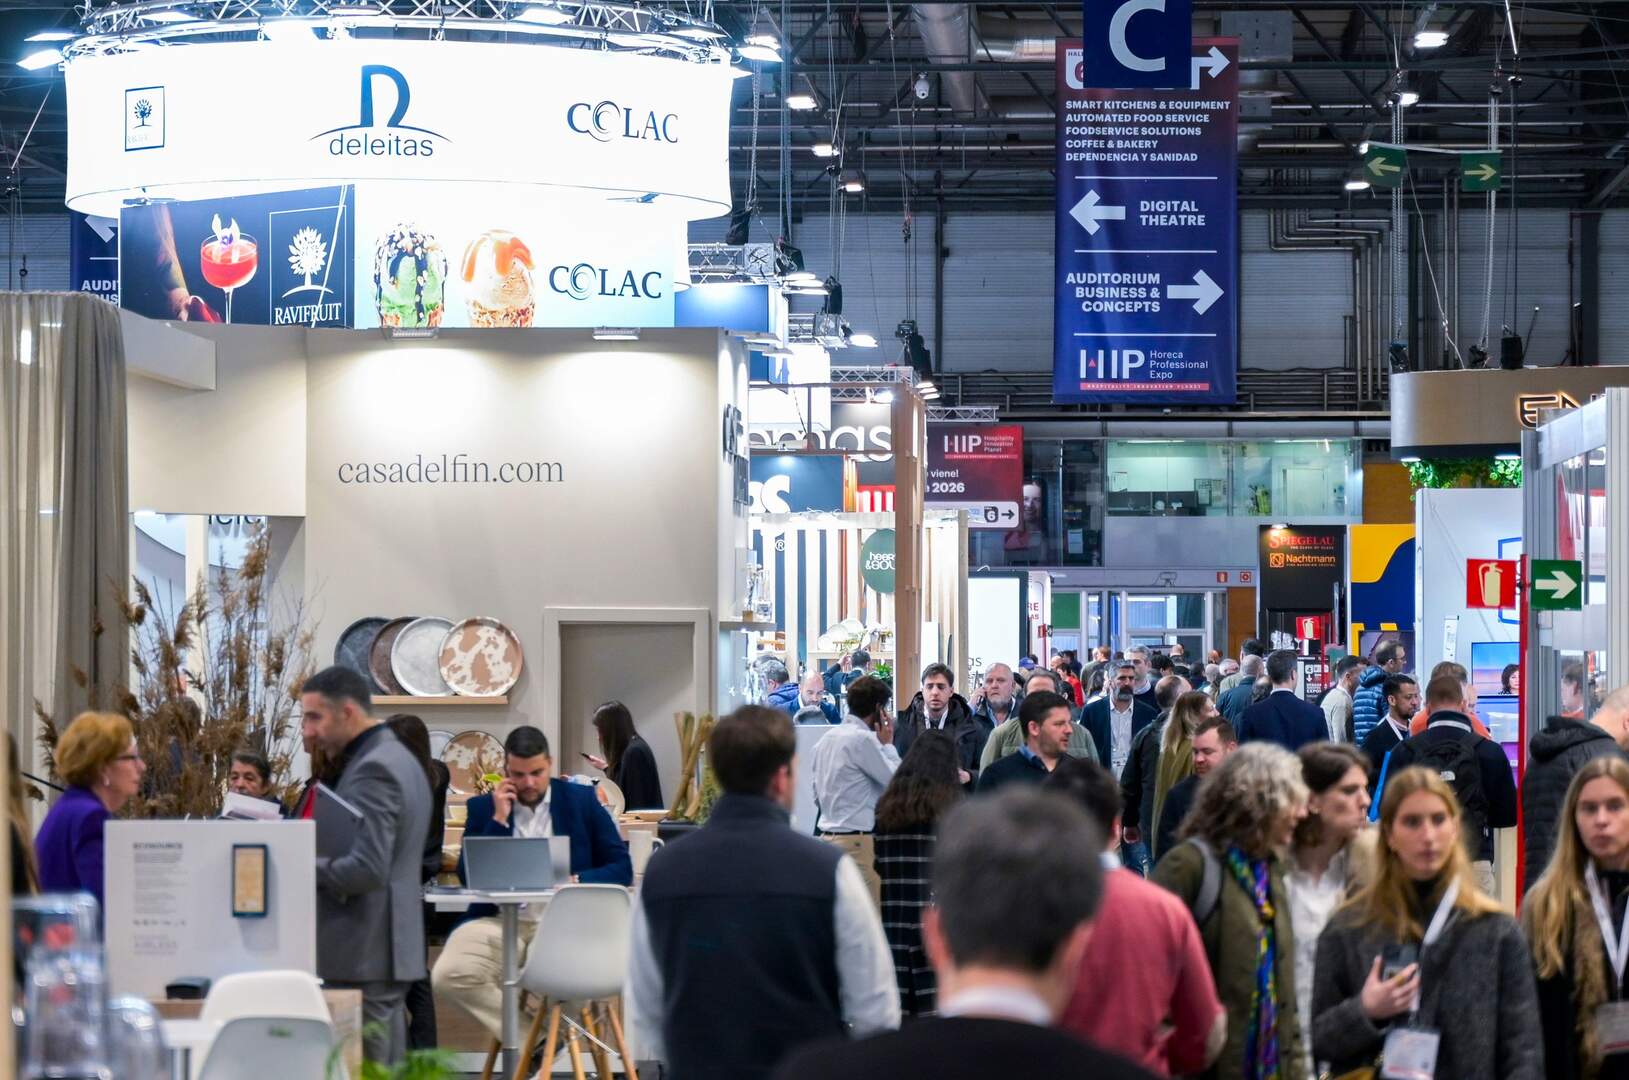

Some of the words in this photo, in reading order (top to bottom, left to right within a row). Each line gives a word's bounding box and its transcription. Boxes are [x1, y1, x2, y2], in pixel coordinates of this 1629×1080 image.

[1109, 0, 1166, 72] C
[1066, 101, 1101, 110] SMART
[1104, 101, 1157, 110] KITCHENS
[1159, 101, 1167, 110] &
[1169, 101, 1231, 111] EQUIPMENT
[566, 100, 679, 144] COLAC
[1066, 114, 1132, 123] AUTOMATED
[1134, 114, 1162, 123] FOOD
[1165, 114, 1210, 123] SERVICE
[1066, 126, 1140, 136] FOODSERVICE
[1141, 127, 1202, 136] SOLUTIONS
[329, 132, 434, 157] deleitas
[1066, 139, 1105, 149] COFFEE
[1107, 140, 1115, 149] &
[1117, 140, 1158, 149] BAKERY
[1066, 153, 1139, 162] DEPENDENCIA
[1141, 153, 1149, 162] Y
[1150, 153, 1198, 162] SANIDAD
[1140, 200, 1199, 212] DIGITAL
[1140, 215, 1206, 226] THEATRE
[548, 262, 662, 301] COLAC
[1066, 272, 1161, 285] AUDITORIUM
[81, 280, 119, 291] AUDI
[1075, 287, 1147, 298] BUSINESS
[1150, 287, 1161, 298] &
[1081, 301, 1161, 313] CONCEPTS
[273, 301, 343, 325] RAVIFRUIT
[1080, 350, 1145, 379] HIP
[1150, 351, 1184, 360] Horeca
[1150, 360, 1209, 370] Professional
[1150, 370, 1173, 380] Expo
[944, 435, 982, 453] HIP
[337, 453, 565, 484] casadelfin.com
[932, 482, 966, 493] 2026
[987, 510, 996, 521] 6
[1269, 535, 1335, 549] SPIEGELAU
[1286, 554, 1336, 563] Nachtmann
